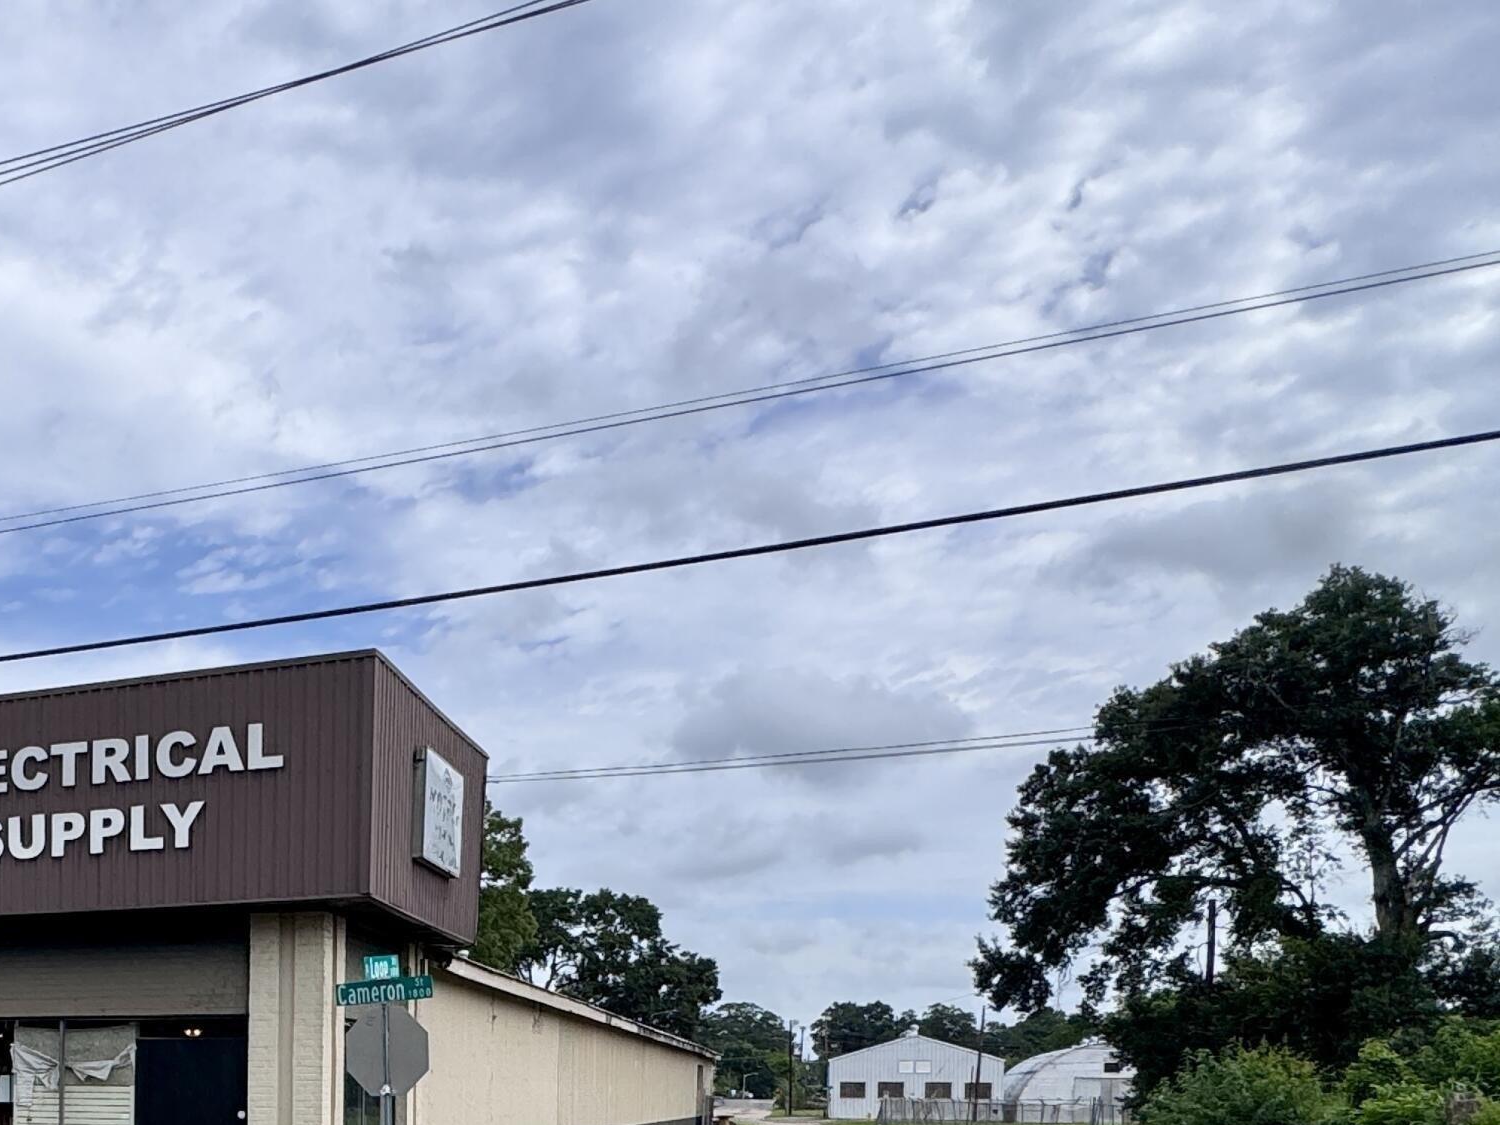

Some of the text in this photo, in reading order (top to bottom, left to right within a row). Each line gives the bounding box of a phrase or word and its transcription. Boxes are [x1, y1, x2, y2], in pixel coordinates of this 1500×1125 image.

[338, 977, 424, 1005] Cameron St
[408, 987, 432, 999] 1800
